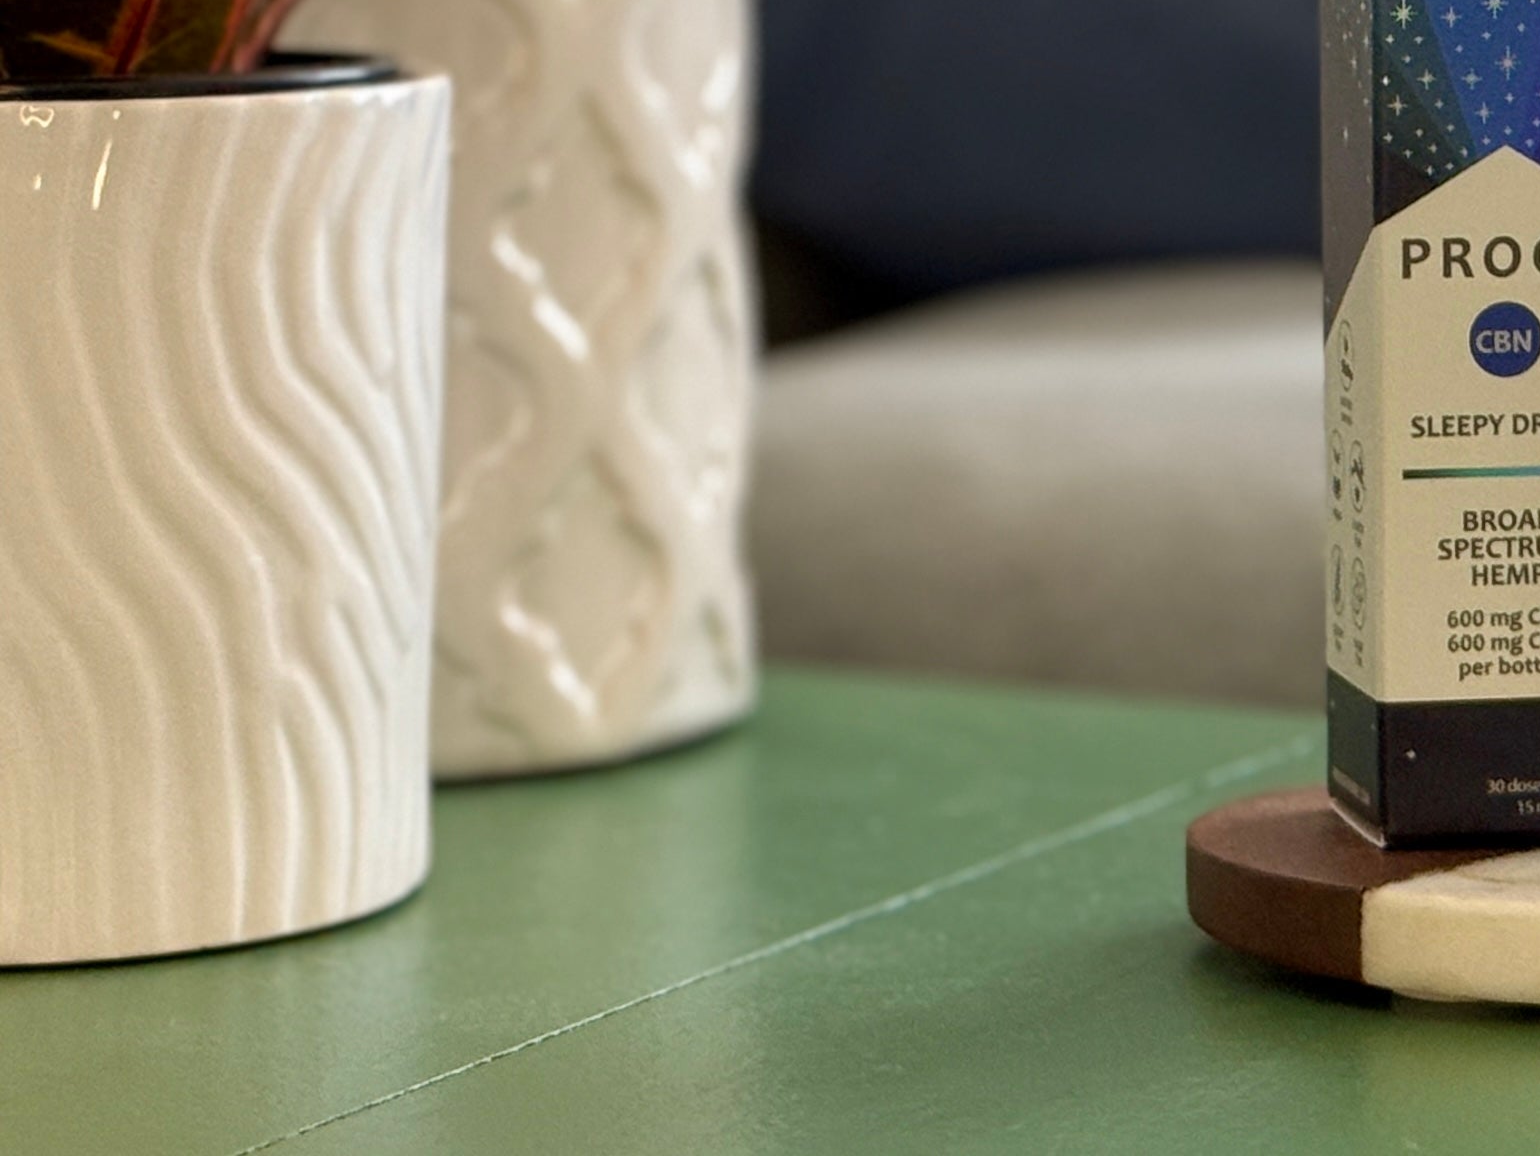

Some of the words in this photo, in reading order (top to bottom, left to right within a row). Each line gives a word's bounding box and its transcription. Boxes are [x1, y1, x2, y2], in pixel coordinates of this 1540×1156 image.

[1475, 329, 1532, 354] CBN
[1411, 413, 1505, 438] SLEEPY
[1447, 609, 1484, 627] 600
[1490, 611, 1523, 630] mg
[1447, 633, 1484, 652] 600
[1491, 635, 1523, 655] mg
[1459, 660, 1493, 681] per
[1487, 779, 1506, 794] 30
[1518, 799, 1534, 814] 15
